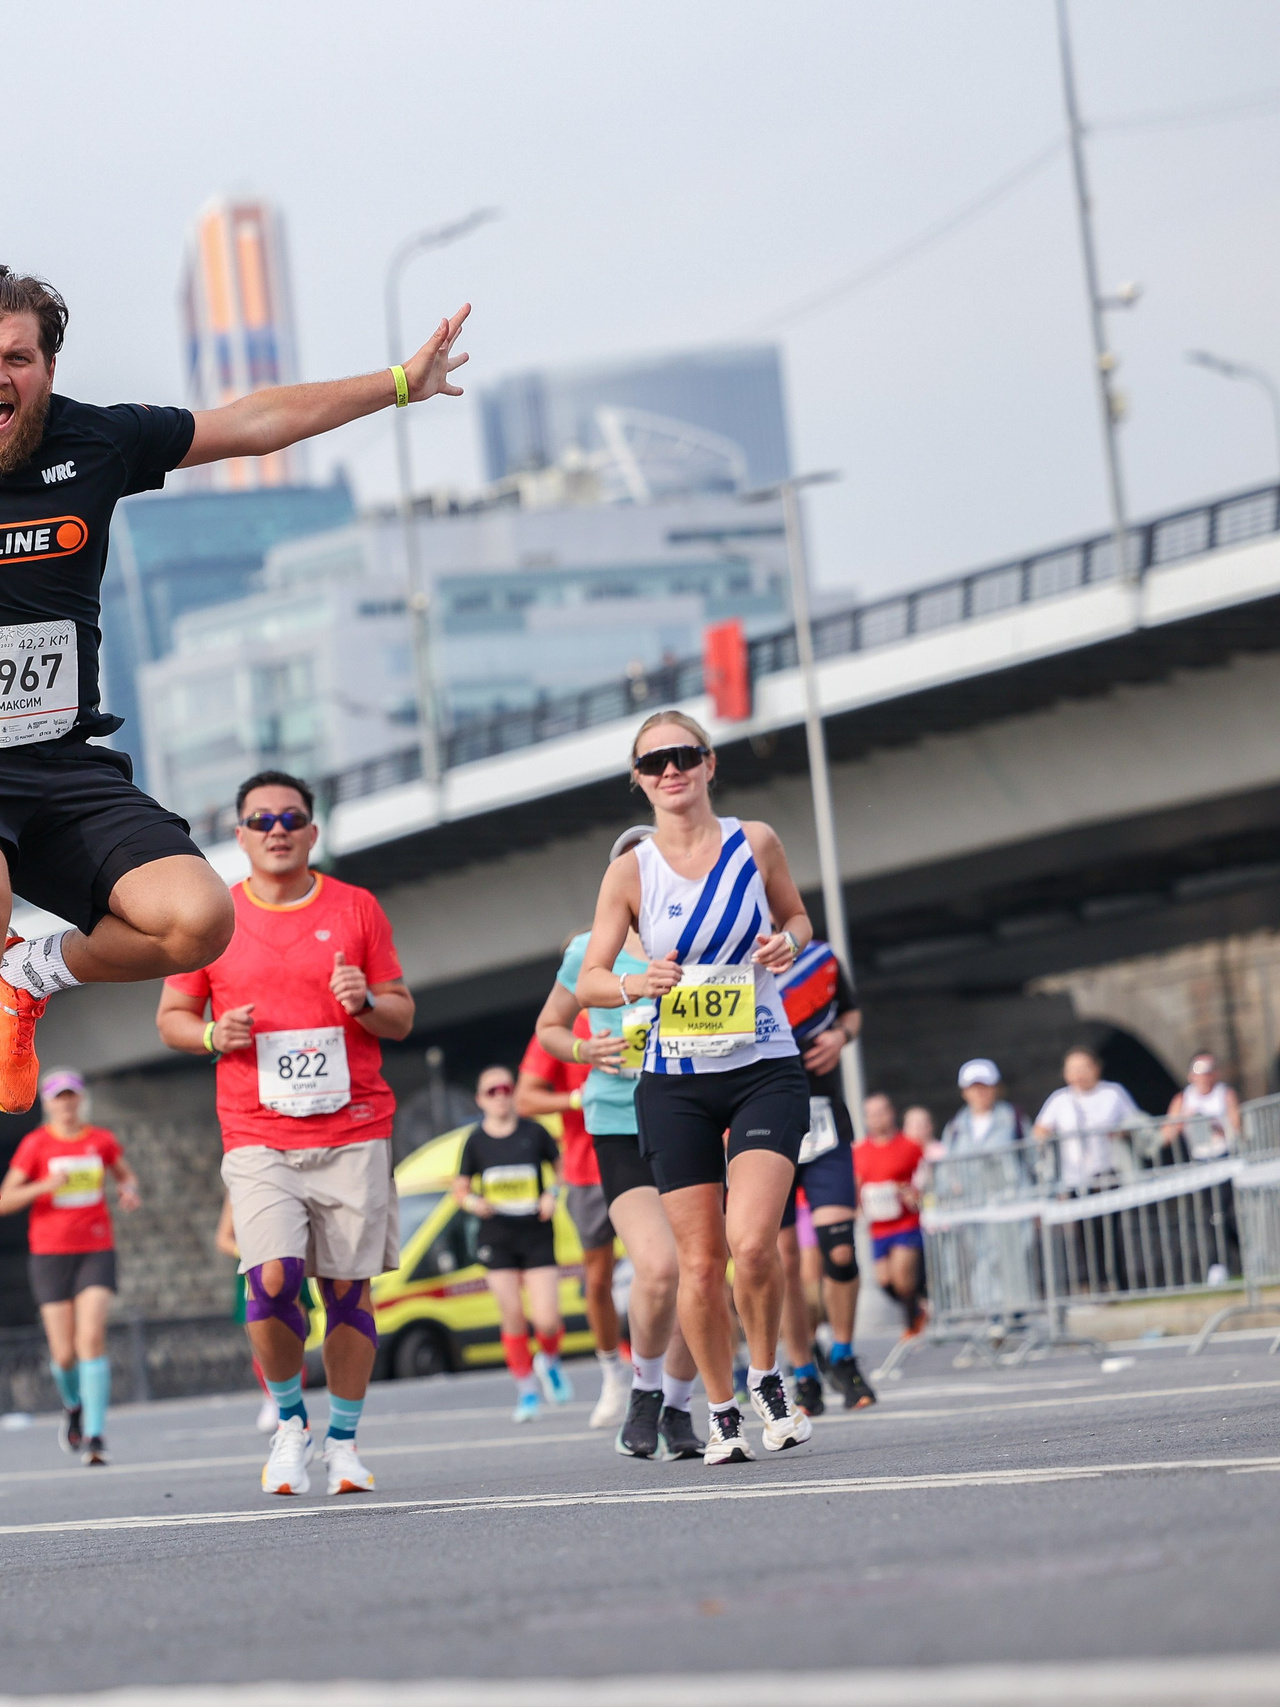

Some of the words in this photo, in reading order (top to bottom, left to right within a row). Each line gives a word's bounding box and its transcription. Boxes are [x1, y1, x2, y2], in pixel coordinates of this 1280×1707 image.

[41, 460, 77, 484] WRC
[18, 636, 45, 650] 42,2
[671, 989, 741, 1018] 4187
[687, 1022, 724, 1030] МАРИНА
[278, 1052, 328, 1079] 822
